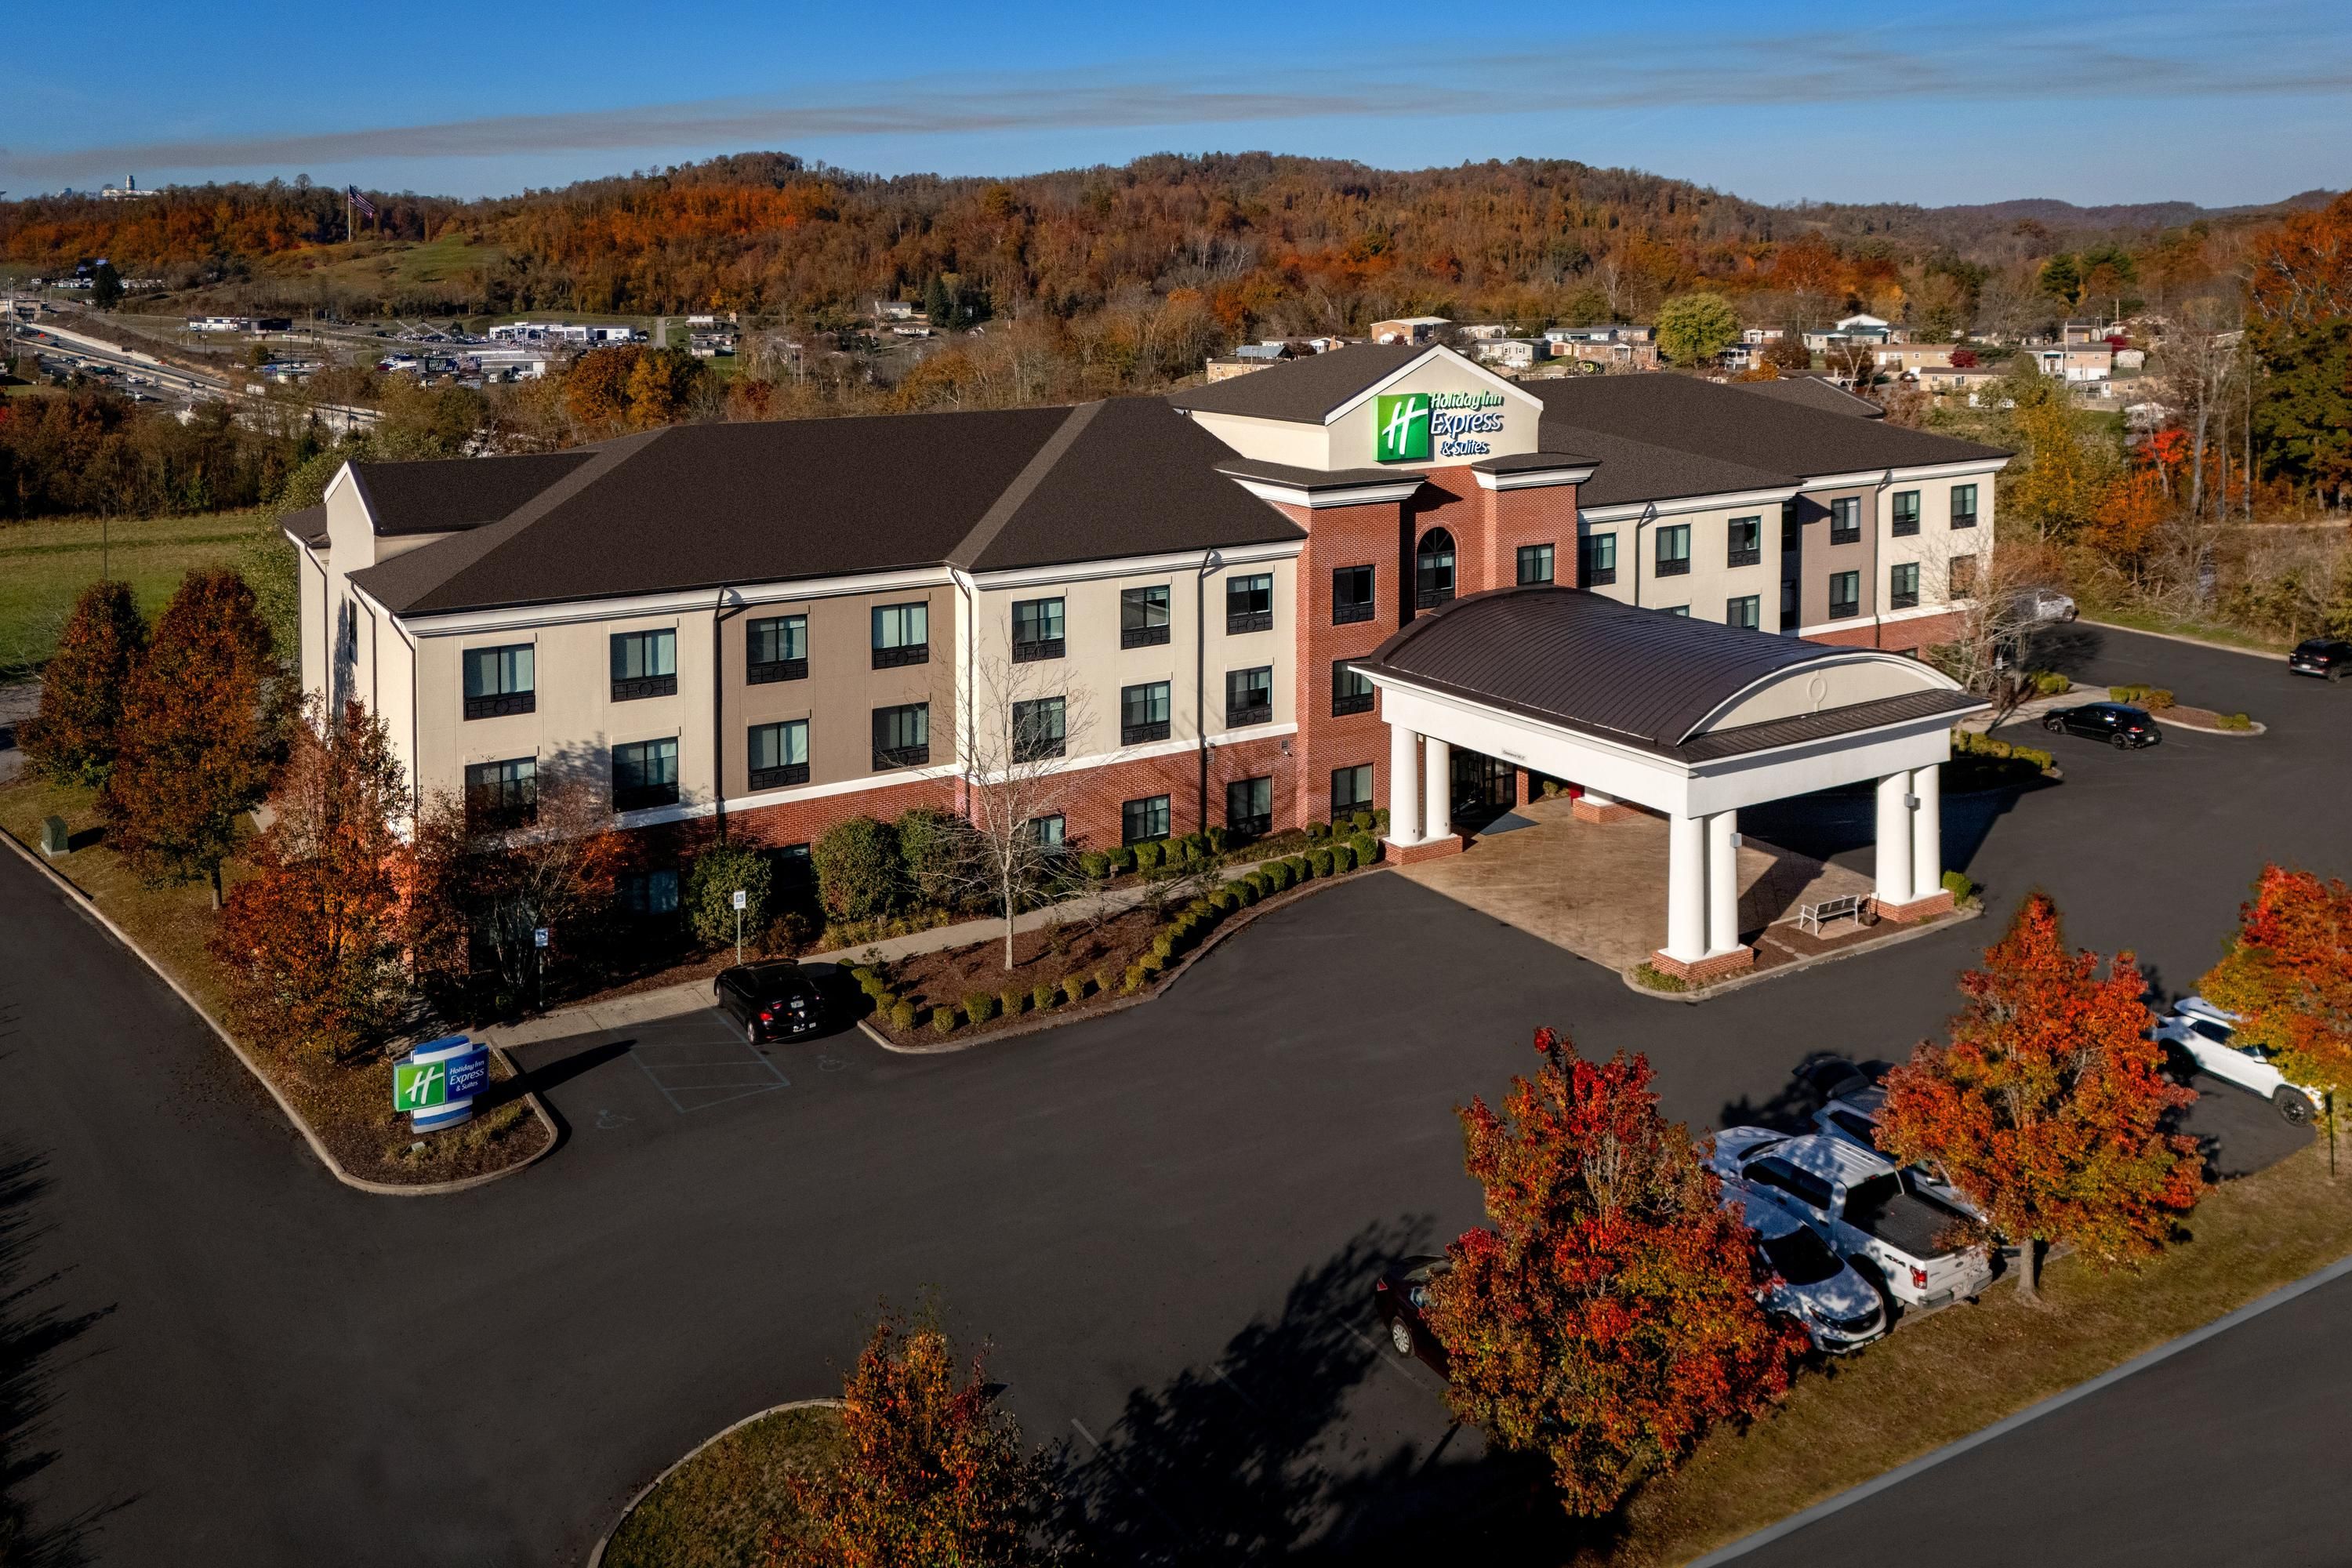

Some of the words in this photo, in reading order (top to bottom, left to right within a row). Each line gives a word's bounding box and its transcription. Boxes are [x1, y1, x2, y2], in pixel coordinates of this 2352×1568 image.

[1430, 390, 1480, 411] Holiday
[1480, 389, 1503, 406] Inn
[1430, 410, 1503, 439] Express
[1442, 441, 1452, 456] &
[1453, 439, 1488, 455] Suites
[449, 1063, 474, 1075] Holiday
[449, 1068, 485, 1086] Express
[461, 1080, 478, 1091] Suites
